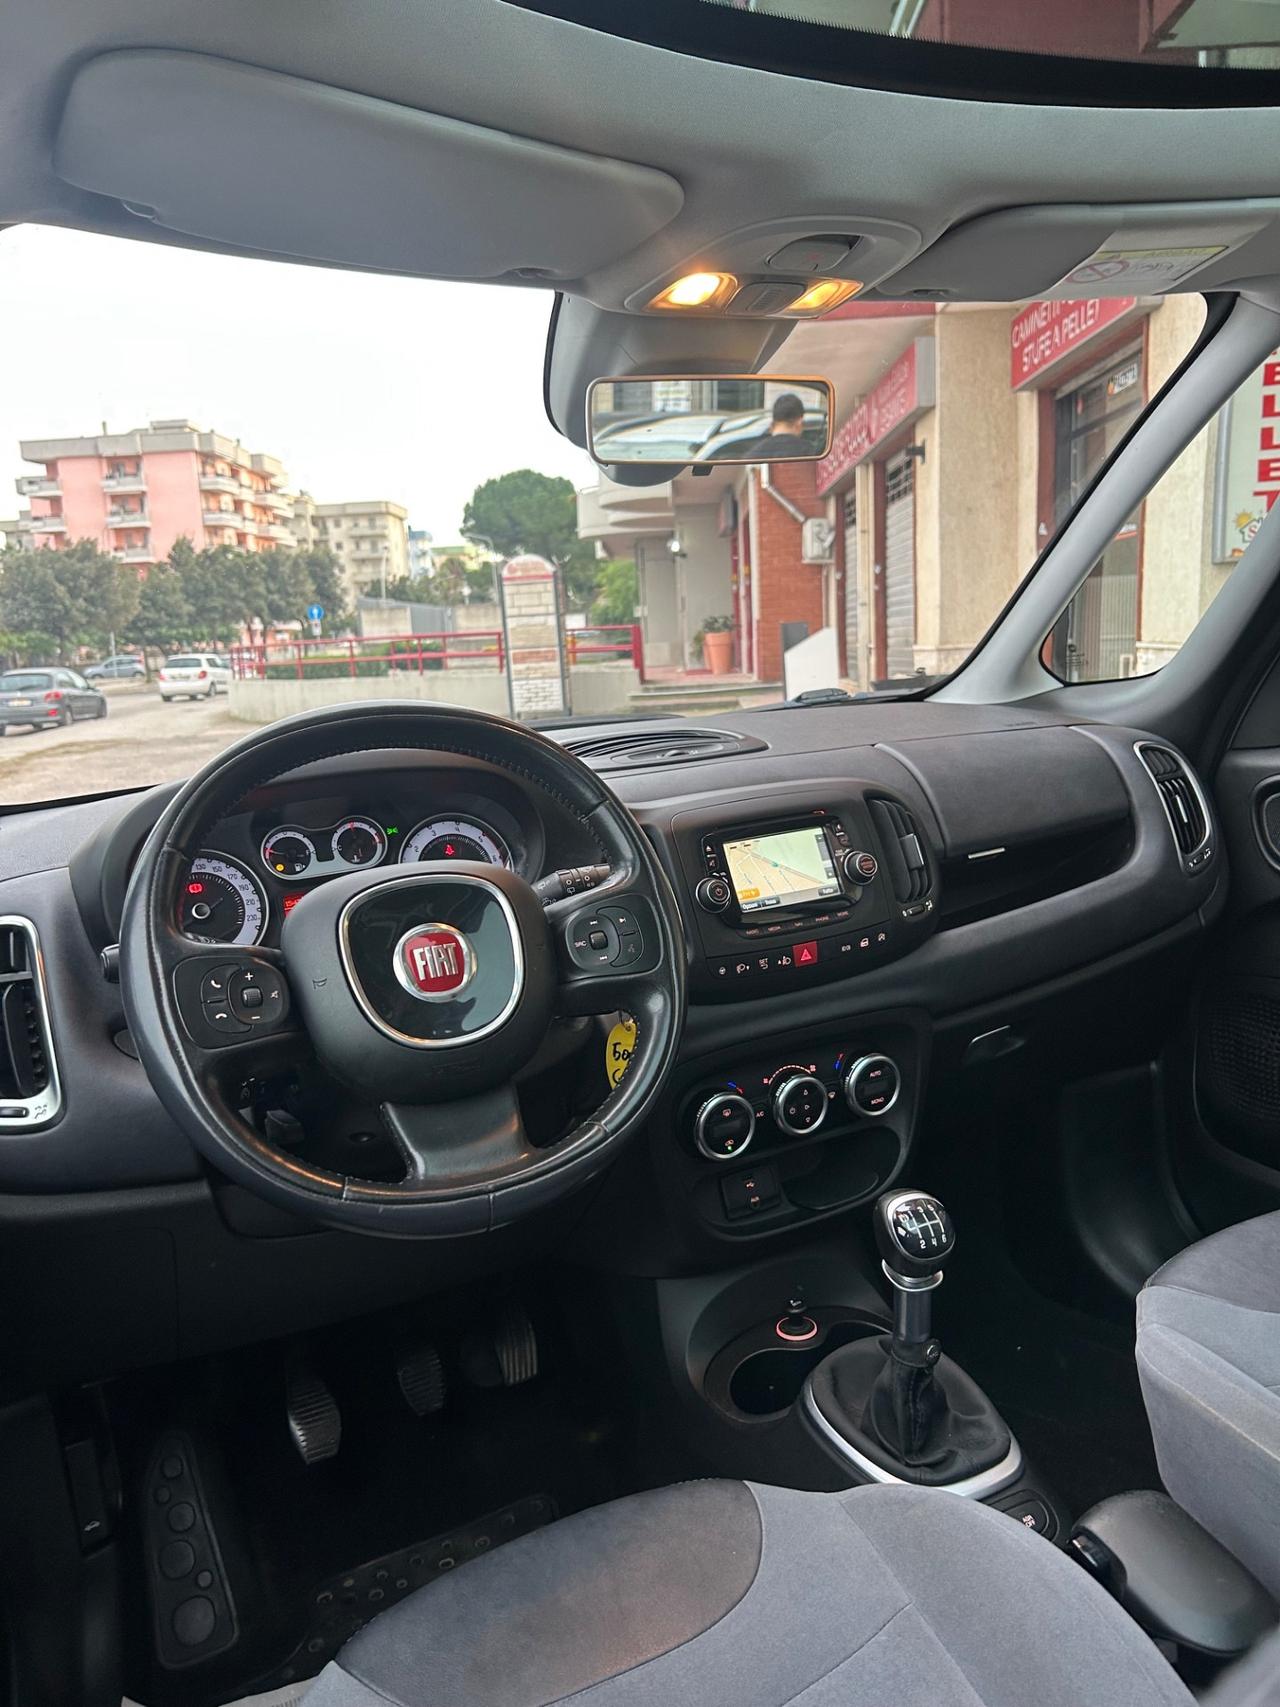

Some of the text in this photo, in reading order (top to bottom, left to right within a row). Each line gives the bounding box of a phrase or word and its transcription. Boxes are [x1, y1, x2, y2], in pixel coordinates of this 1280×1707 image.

[1022, 299, 1100, 372] STUFE A PELLET
[1253, 351, 1280, 512] ELLET
[413, 943, 459, 981] FIAT
[920, 1234, 947, 1249] 2 4 6
